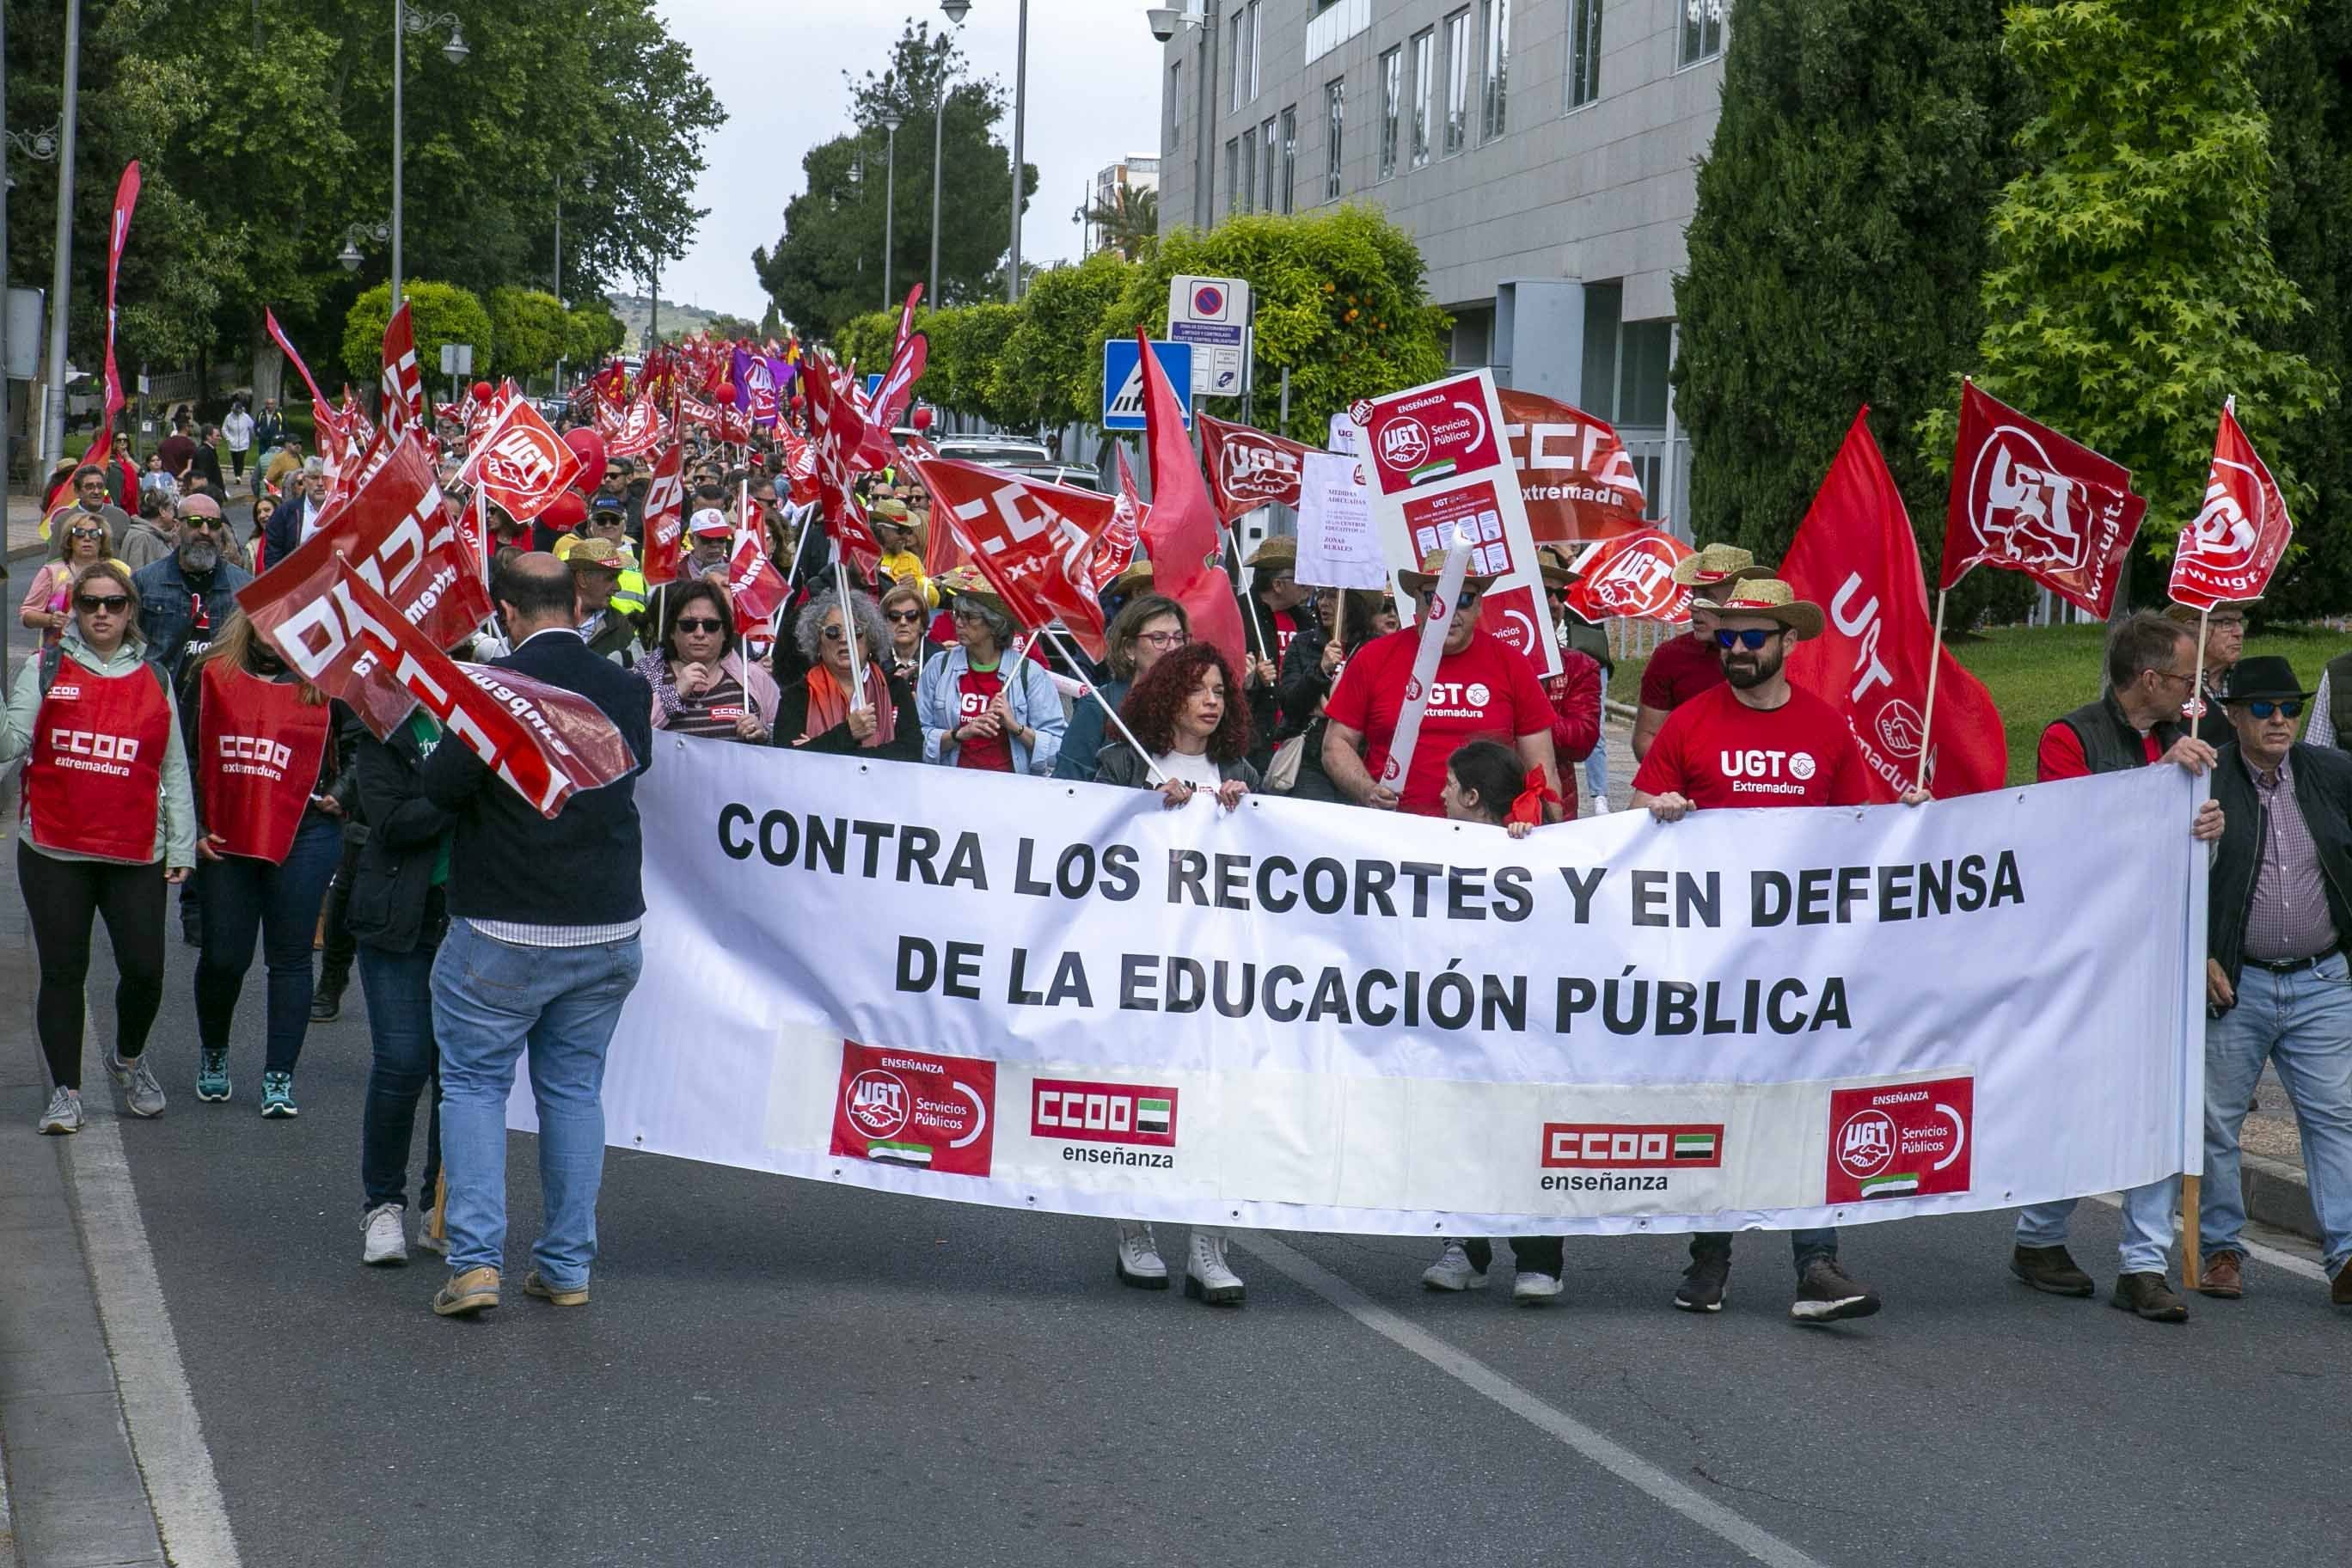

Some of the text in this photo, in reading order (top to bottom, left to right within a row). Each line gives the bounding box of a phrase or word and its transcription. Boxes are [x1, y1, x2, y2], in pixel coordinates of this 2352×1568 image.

[1398, 394, 1447, 413] ENSEÑANZA
[1385, 424, 1423, 447] UGT
[1431, 418, 1471, 435] Servicios
[1434, 431, 1471, 446] Públicos
[493, 430, 554, 488] UGT
[1227, 443, 1297, 476] UGT
[1432, 497, 1449, 508] UGT
[1608, 550, 1674, 600] UGT
[961, 693, 990, 714] GT
[1428, 683, 1463, 705] GT
[1424, 707, 1484, 718] xtremadura
[52, 728, 139, 763] CCOO
[219, 735, 292, 770] CCOO
[55, 756, 130, 776] extremadura
[1721, 750, 1786, 778] UGT
[1733, 780, 1805, 795] Extremadura
[718, 803, 2025, 928] CONTRA LOS RECORTES Y EN DEFENSA
[895, 935, 1853, 1036] DE LA EDUCACIÓN PÚBLICA
[881, 1057, 945, 1075] ENSEÑANZA
[857, 1080, 902, 1112] UGT
[916, 1097, 967, 1115] Servicios
[1872, 1091, 1929, 1106] ENSEÑANZA
[915, 1112, 963, 1130] Públicos
[1038, 1090, 1132, 1131] CCOO
[1846, 1120, 1889, 1148] UGT
[1902, 1124, 1948, 1139] Servicios
[1063, 1144, 1174, 1169] enseñanza
[1551, 1132, 1669, 1161] CCOO
[1902, 1139, 1945, 1154] Públicos
[1540, 1171, 1669, 1191] enseñanza
